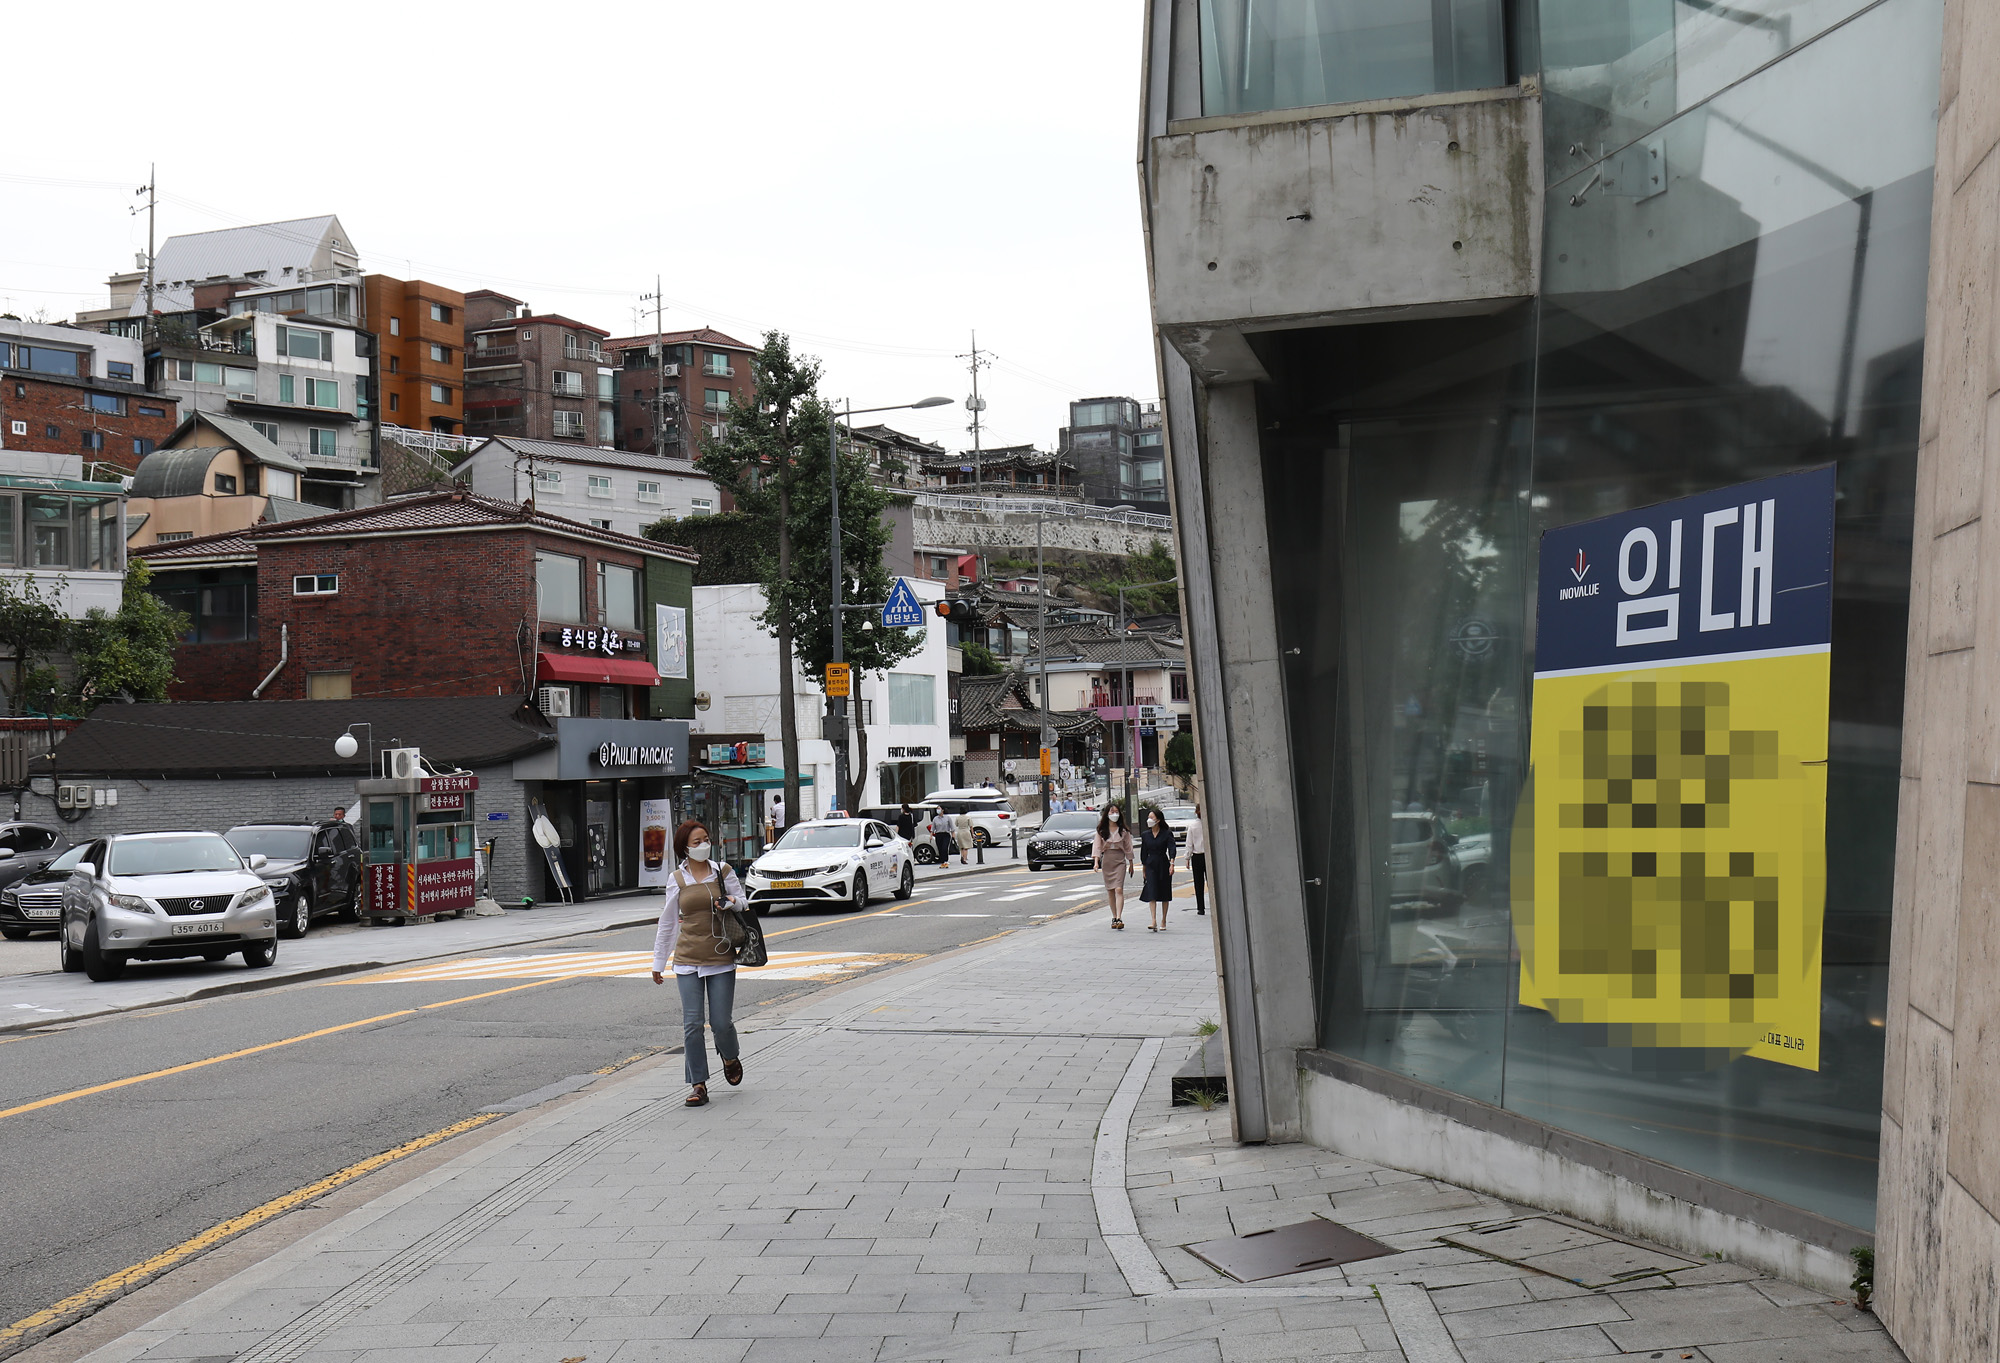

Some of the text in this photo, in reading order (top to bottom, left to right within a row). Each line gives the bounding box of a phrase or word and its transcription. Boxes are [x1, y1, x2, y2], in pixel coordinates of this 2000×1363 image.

[1615, 498, 1776, 648] 임대
[1559, 582, 1600, 601] INOVALUE
[885, 612, 920, 624] 횡단보도
[561, 627, 598, 650] 중식당
[887, 746, 932, 758] FRITZ HANSEN
[430, 777, 470, 791] 삼청동 수제비
[430, 795, 460, 807] 전용주차장
[418, 868, 474, 886] 식사하시는 동안만 주차가능
[386, 864, 395, 909] 전용주차장
[197, 924, 219, 932] 6016
[1767, 1032, 1781, 1046] 대표
[1783, 1035, 1805, 1051] 김나라
